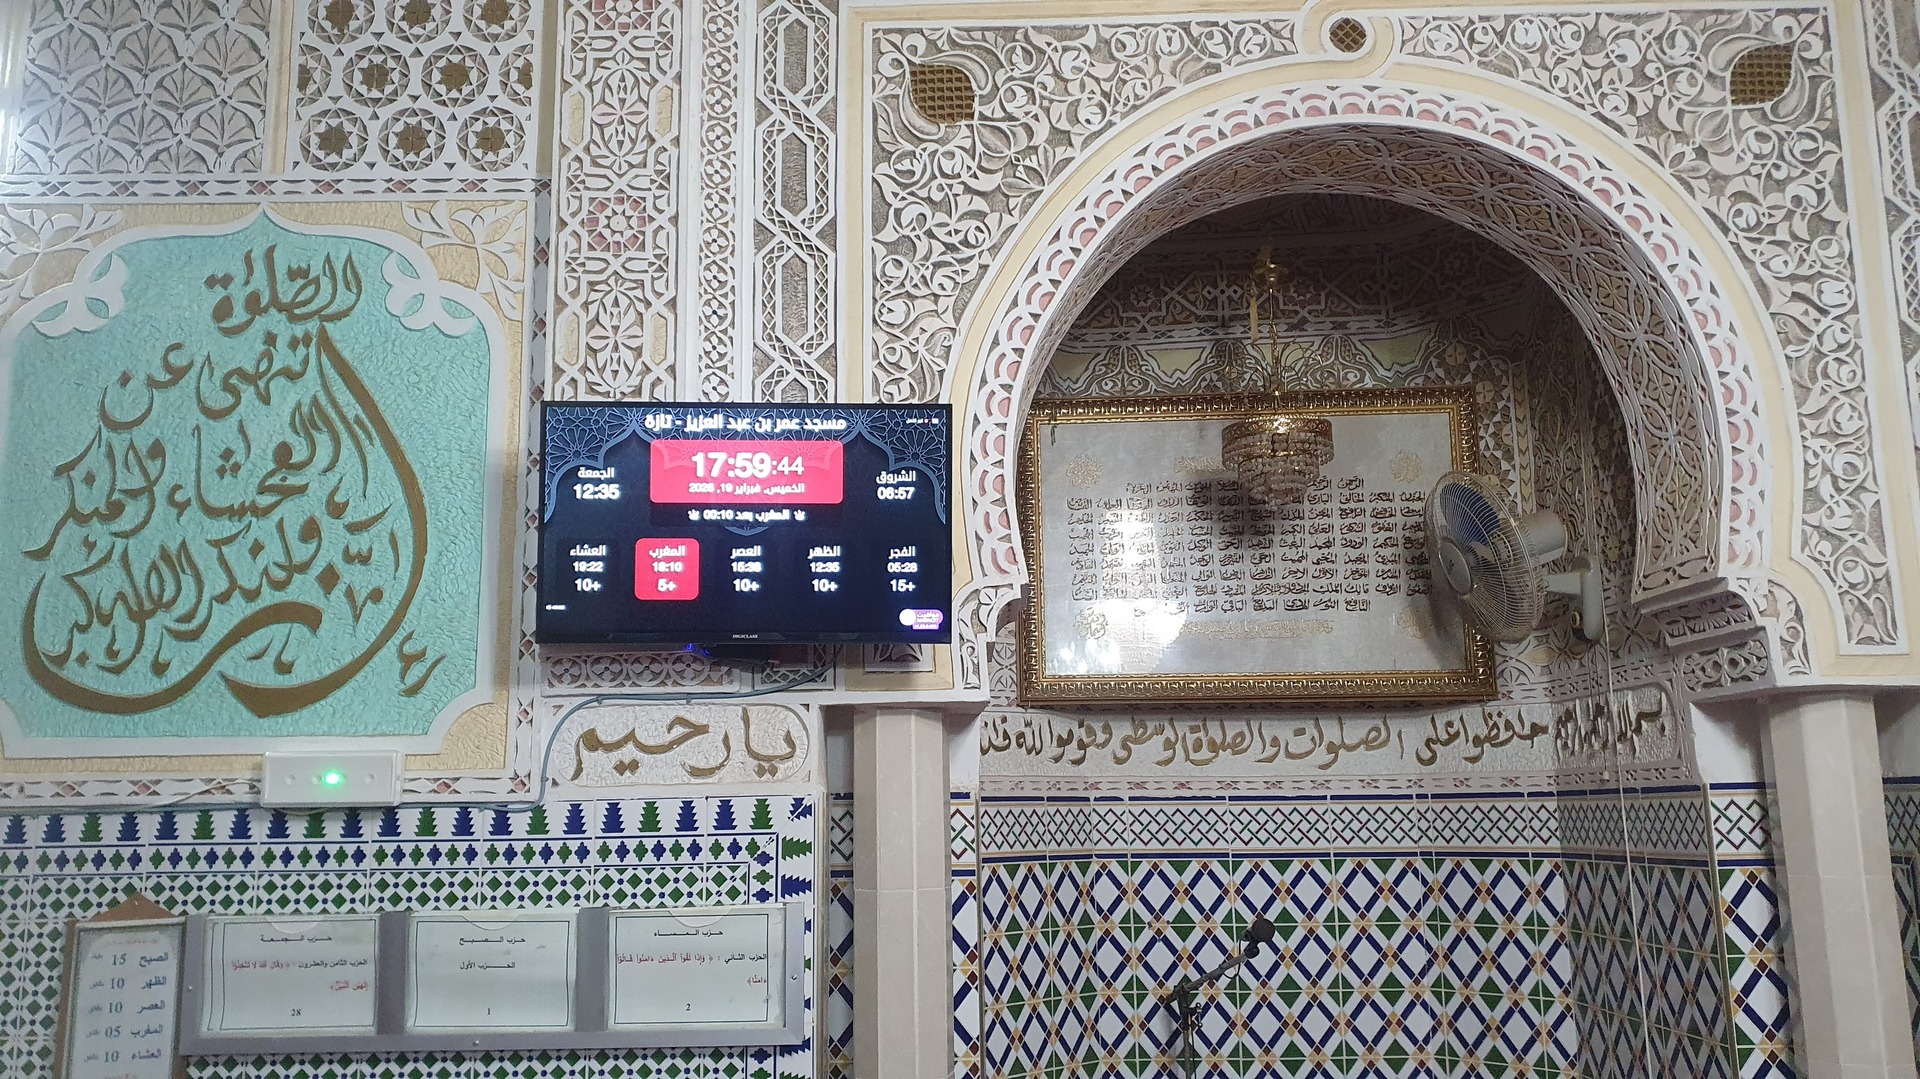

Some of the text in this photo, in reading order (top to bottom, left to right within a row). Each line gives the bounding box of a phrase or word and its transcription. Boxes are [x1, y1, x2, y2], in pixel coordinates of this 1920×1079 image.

[100, 342, 194, 430] عن
[644, 413, 672, 432] تازة
[684, 414, 723, 432] العزيز
[727, 417, 751, 431] عبد
[755, 417, 772, 432] بن
[776, 418, 801, 432] عمر
[802, 417, 847, 432] مسجد
[691, 451, 805, 479] 17:59:44
[577, 466, 615, 480] الجمعة
[876, 469, 916, 484] الشروق
[573, 483, 620, 499] 12:35
[688, 483, 715, 493] 2026
[734, 482, 761, 495] فبراير
[877, 487, 915, 500] 06:57
[703, 509, 790, 522] المغرب بعد 00:10
[569, 544, 606, 557] العشاء
[649, 545, 686, 559] المغرب
[730, 545, 761, 559] العصر
[807, 545, 840, 559] الظهر
[888, 546, 916, 559] الفجر
[572, 561, 604, 573] 19:22
[652, 561, 683, 573] 18:10
[809, 562, 840, 573] 12:35
[887, 562, 918, 573] 05:28
[1415, 713, 1460, 766] على
[1460, 707, 1549, 764] حافظوا
[571, 705, 797, 782] يا رحيم
[260, 934, 332, 944] حزب الجمعة
[654, 929, 724, 938] حزب المساء
[459, 936, 526, 946] حزب الصبح
[112, 953, 127, 966] 15
[139, 952, 169, 967] الصبح
[329, 959, 347, 968] الثامن
[349, 958, 367, 967] الحزب
[724, 952, 745, 965] الثاني
[748, 953, 767, 962] الحزب
[459, 960, 516, 970] الحزب الأول
[111, 978, 125, 990] 10
[140, 976, 167, 989] الظهر
[109, 1001, 123, 1014] 10
[137, 1000, 165, 1014] العصر
[685, 1003, 691, 1011] 2
[104, 1025, 122, 1038] 05
[130, 1024, 163, 1038] المغرب
[104, 1050, 119, 1063] 10
[131, 1049, 162, 1061] العشاء
